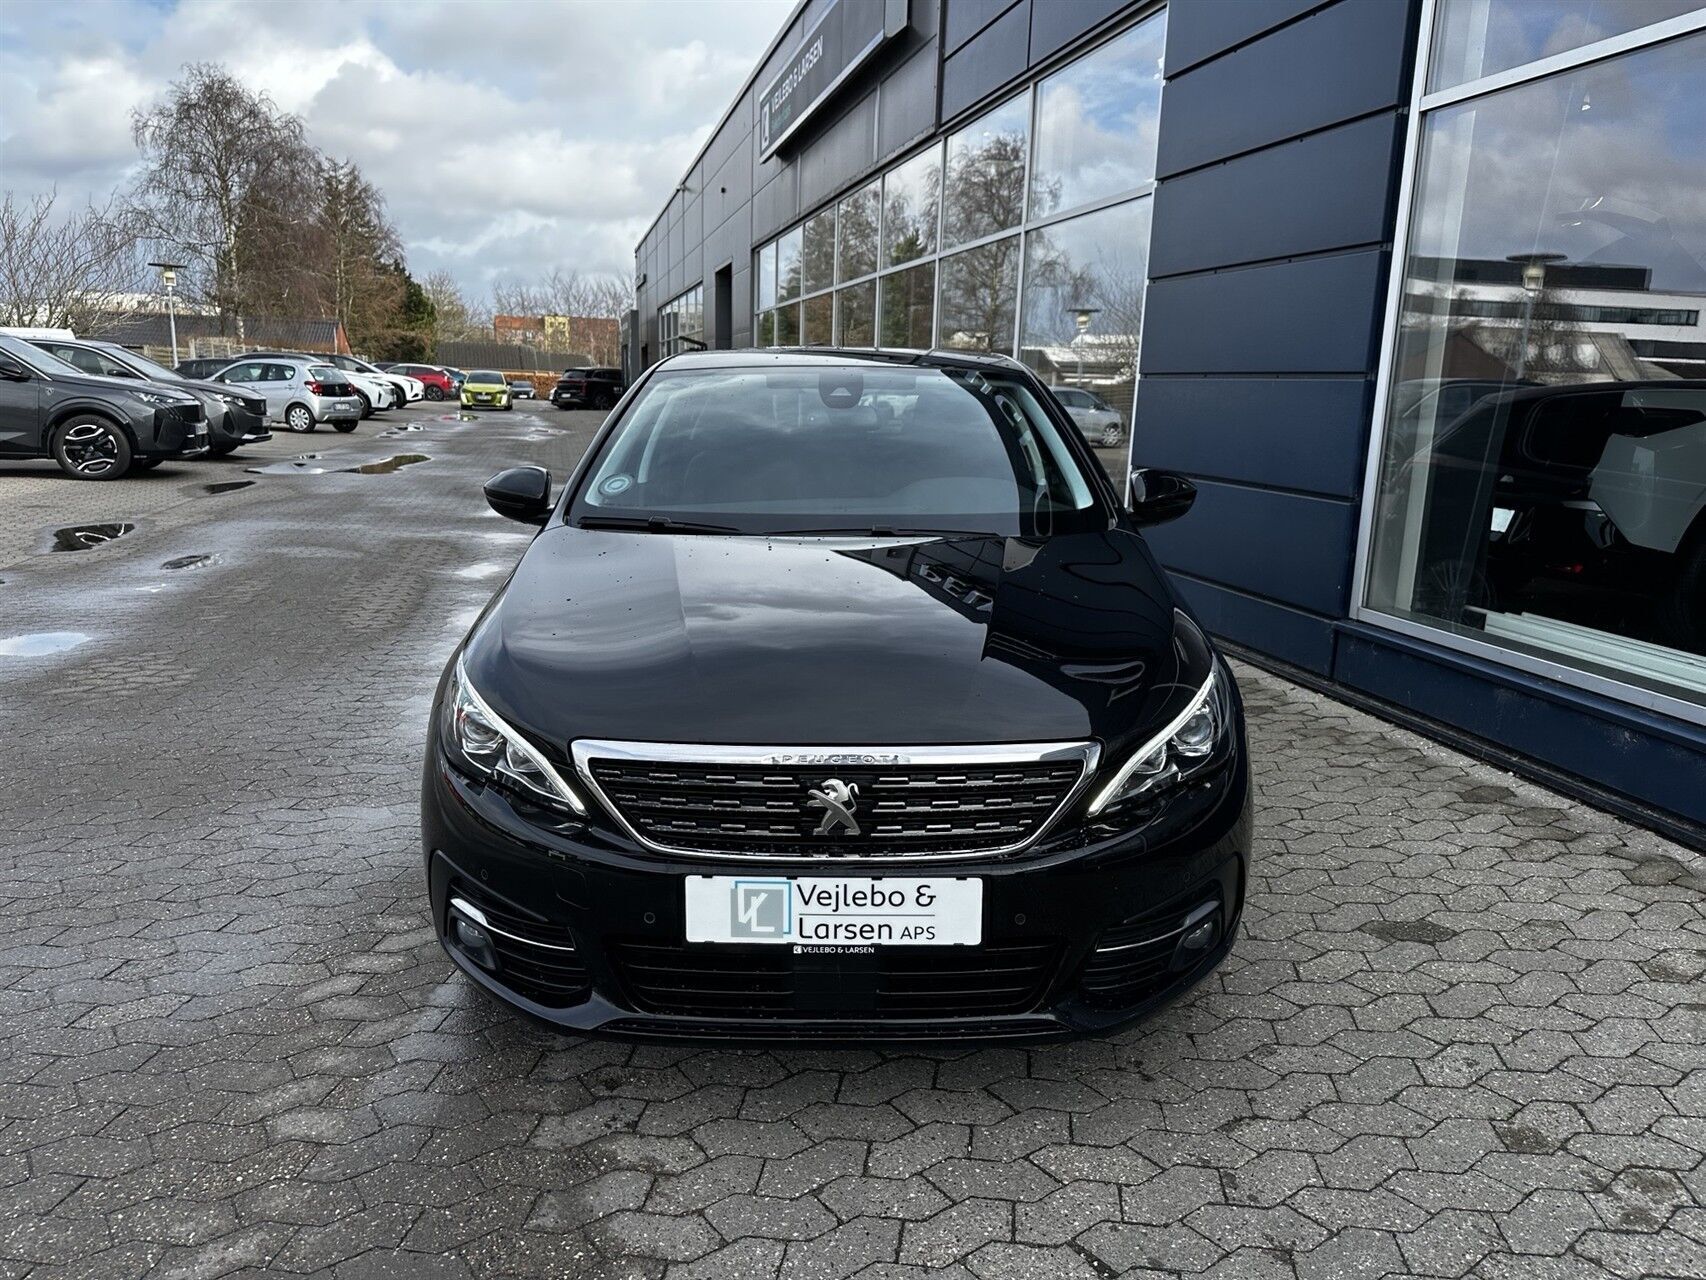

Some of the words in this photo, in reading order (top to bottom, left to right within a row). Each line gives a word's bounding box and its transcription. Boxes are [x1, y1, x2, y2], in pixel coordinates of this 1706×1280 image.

[798, 35, 823, 82] LARSEN
[796, 884, 905, 912] Vejlebo
[915, 884, 936, 907] &
[799, 917, 892, 939] Larsen
[900, 926, 935, 939] APS
